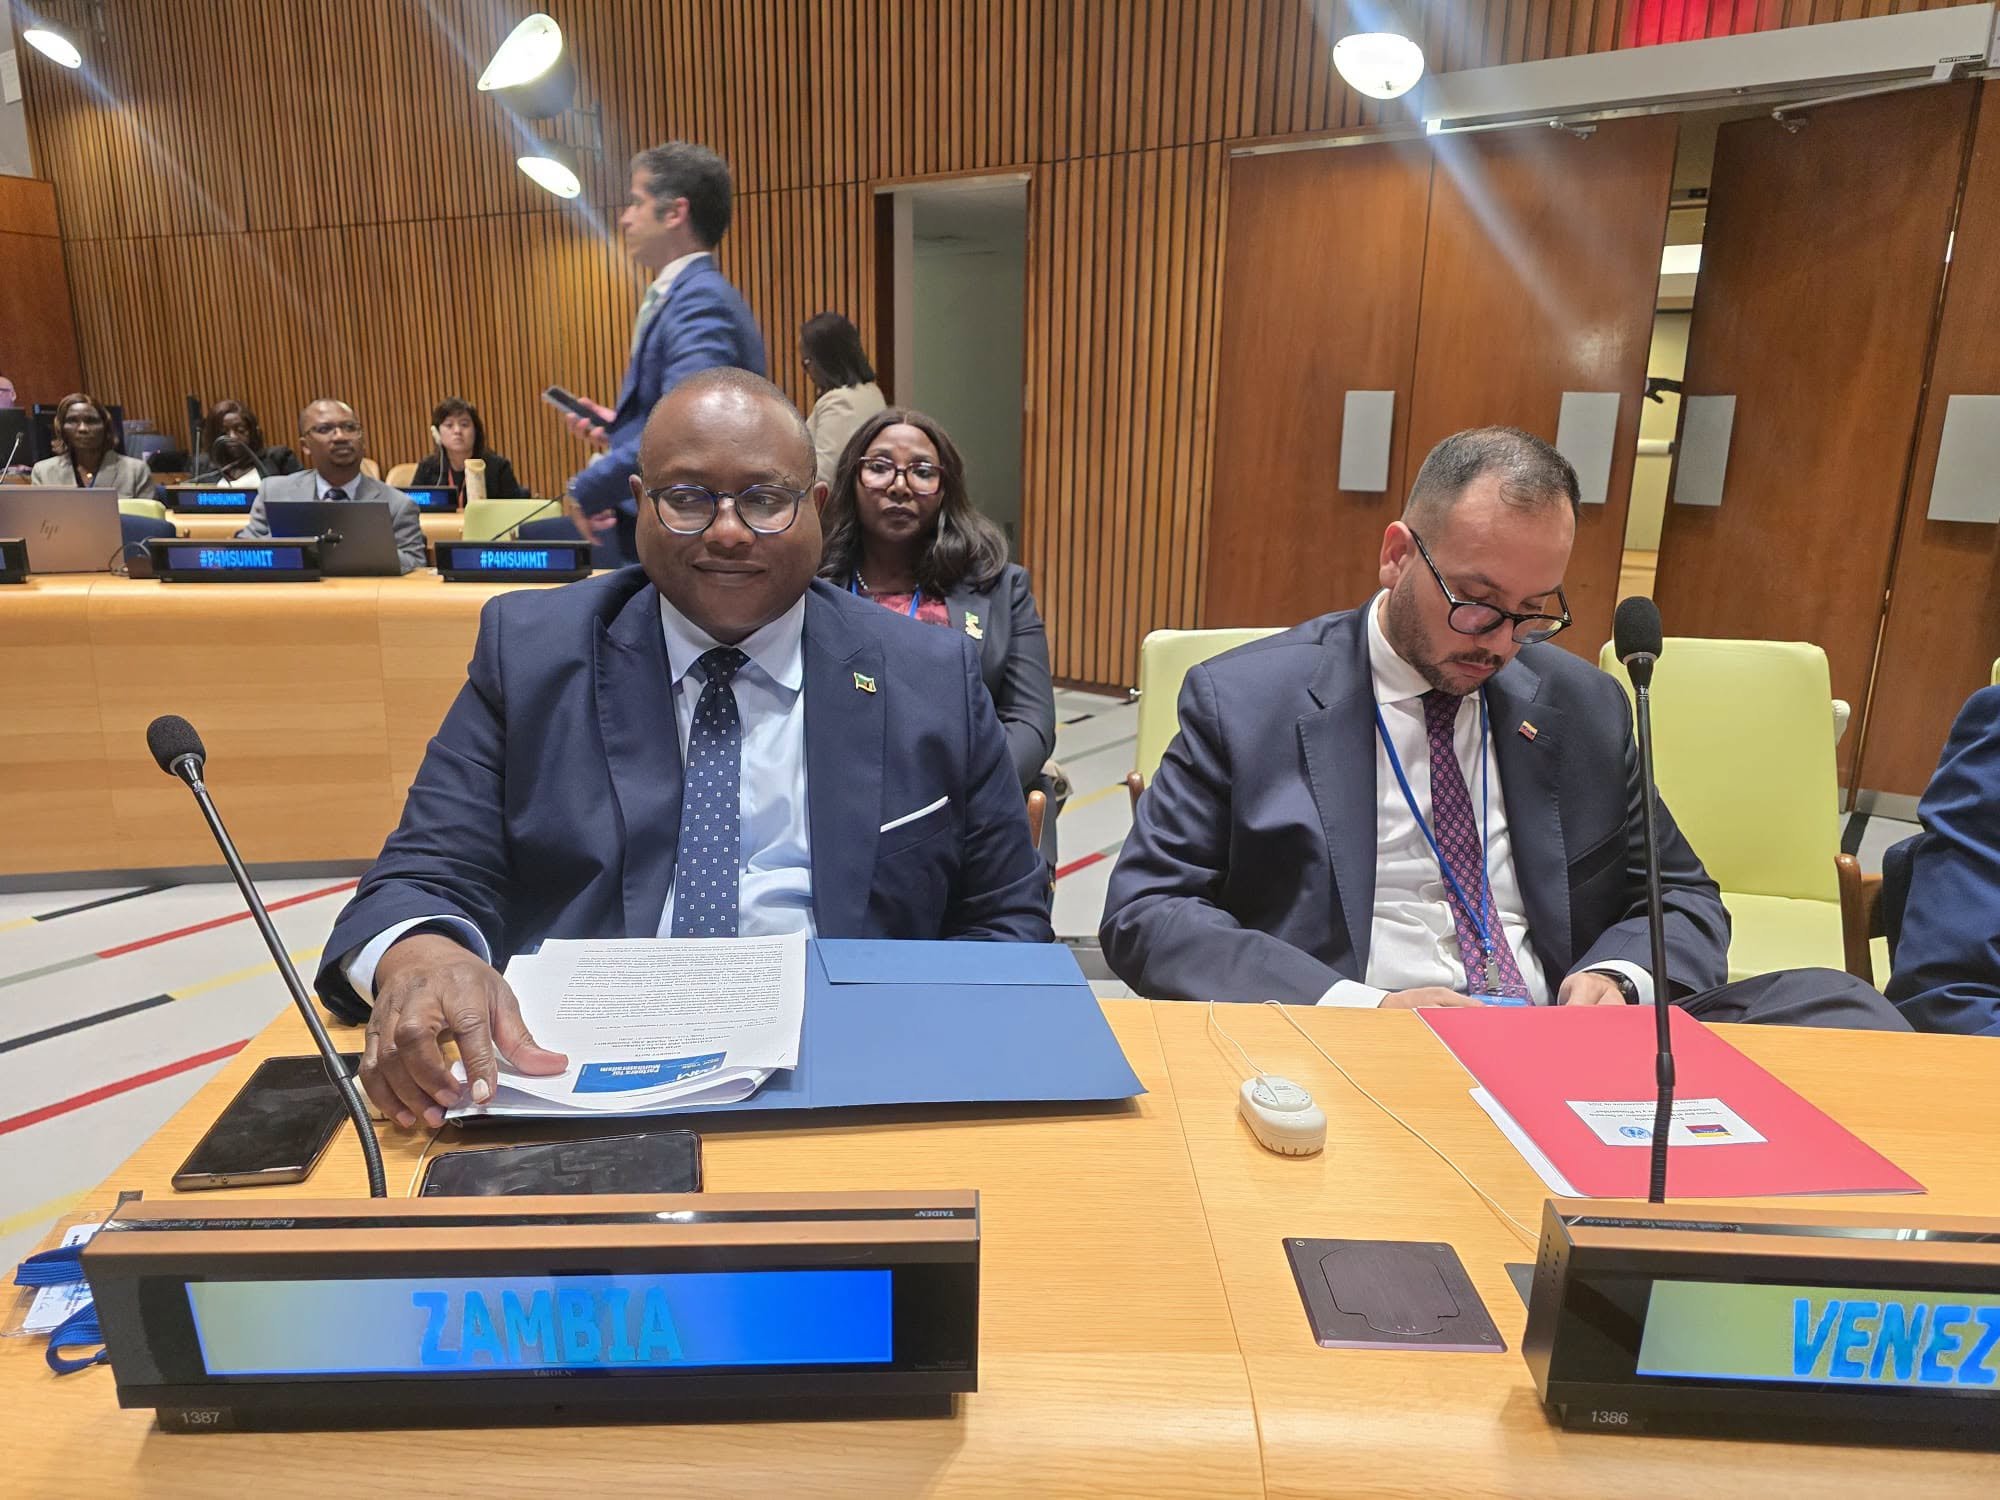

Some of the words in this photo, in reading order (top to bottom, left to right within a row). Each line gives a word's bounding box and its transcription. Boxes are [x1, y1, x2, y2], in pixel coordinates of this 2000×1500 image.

[199, 549, 273, 568] #P4MSUMMIT
[480, 550, 548, 568] #P4MSUMMIT
[411, 1286, 685, 1366] ZAMBIA
[1793, 1297, 2000, 1385] VENEZ
[180, 1411, 220, 1424] 1387
[1590, 1410, 1629, 1425] 1386
